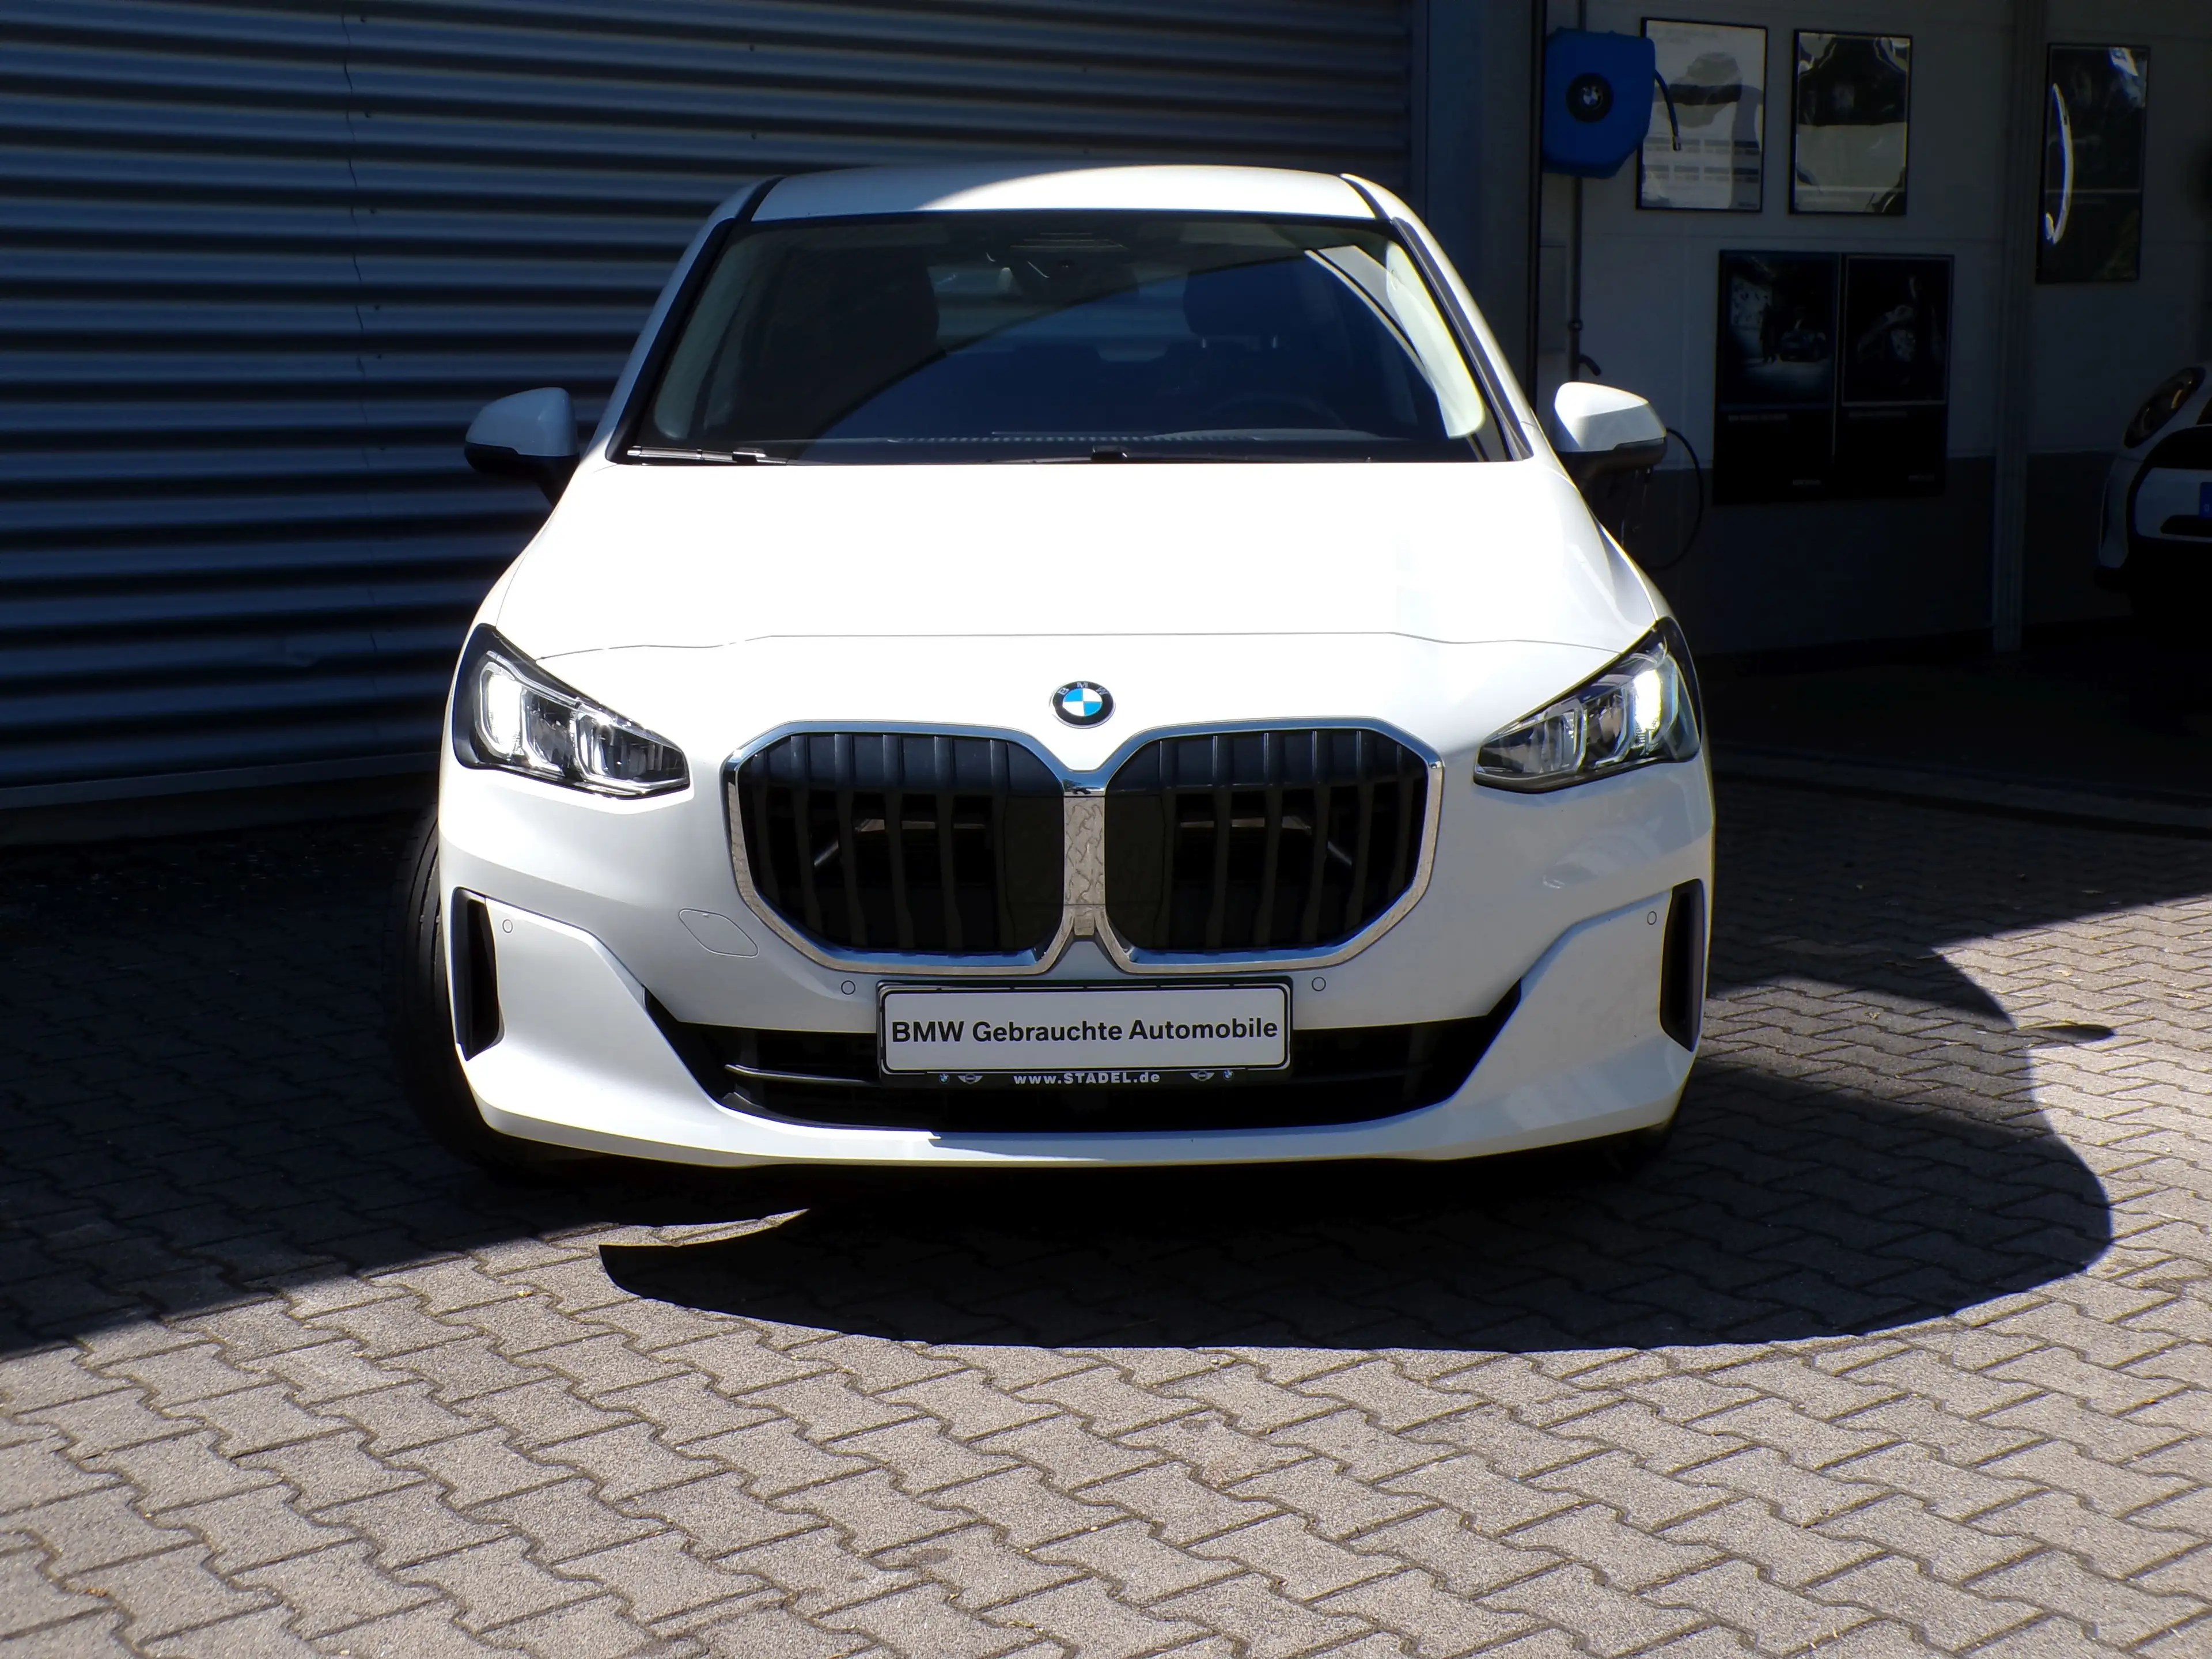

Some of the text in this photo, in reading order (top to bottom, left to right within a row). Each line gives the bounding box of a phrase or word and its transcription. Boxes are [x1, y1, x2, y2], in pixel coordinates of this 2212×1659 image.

[1057, 681, 1109, 696] BMW
[892, 1017, 1278, 1043] BMW Gebrauchte Automobile
[1013, 1071, 1161, 1085] www.STADEL.de
